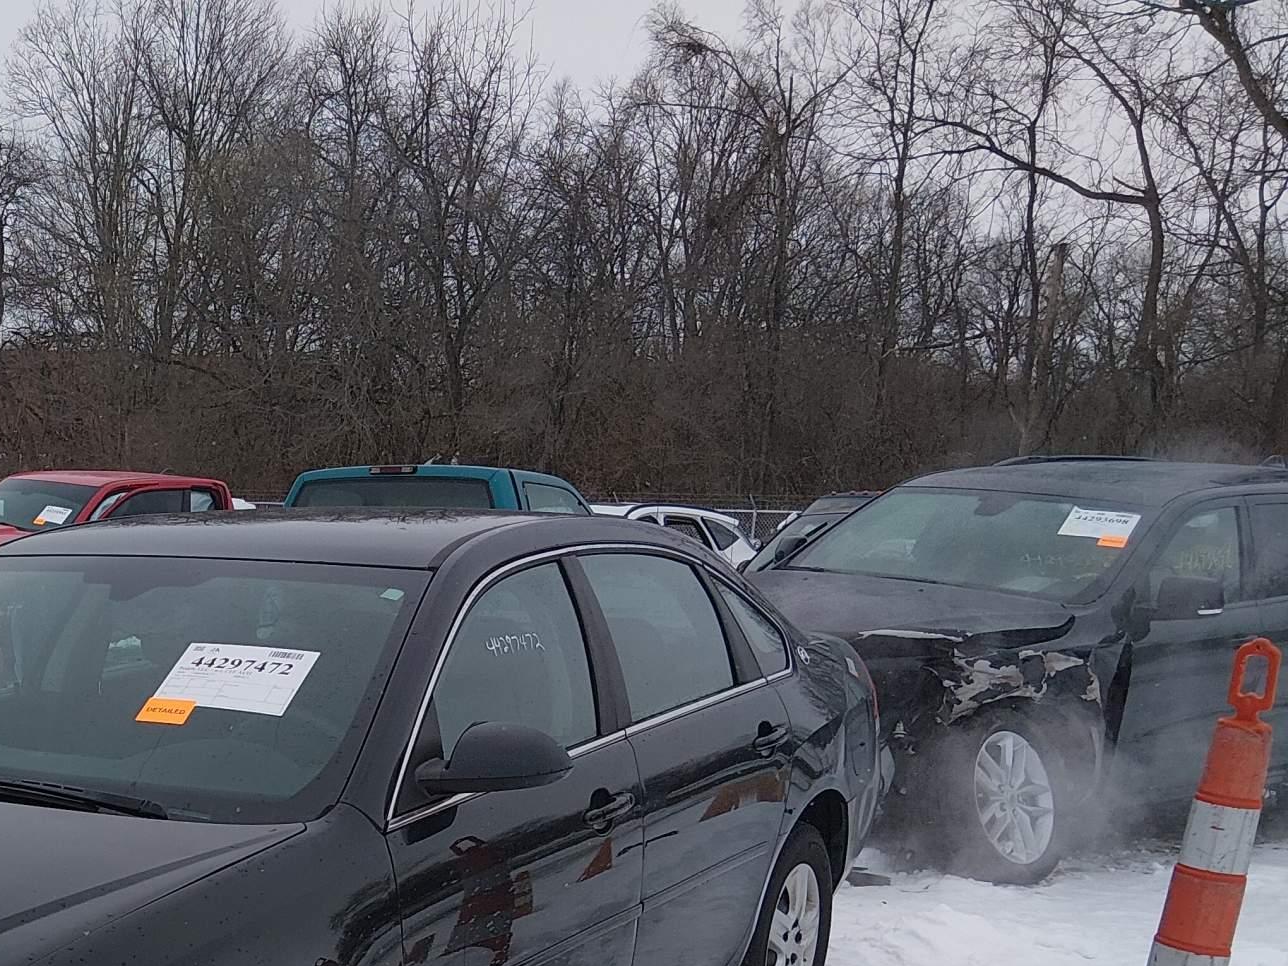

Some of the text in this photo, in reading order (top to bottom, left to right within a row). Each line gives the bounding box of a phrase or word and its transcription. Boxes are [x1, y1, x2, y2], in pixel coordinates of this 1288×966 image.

[485, 632, 546, 657] 44297472
[191, 656, 294, 676] 44297472
[146, 706, 186, 715] DETAILED
